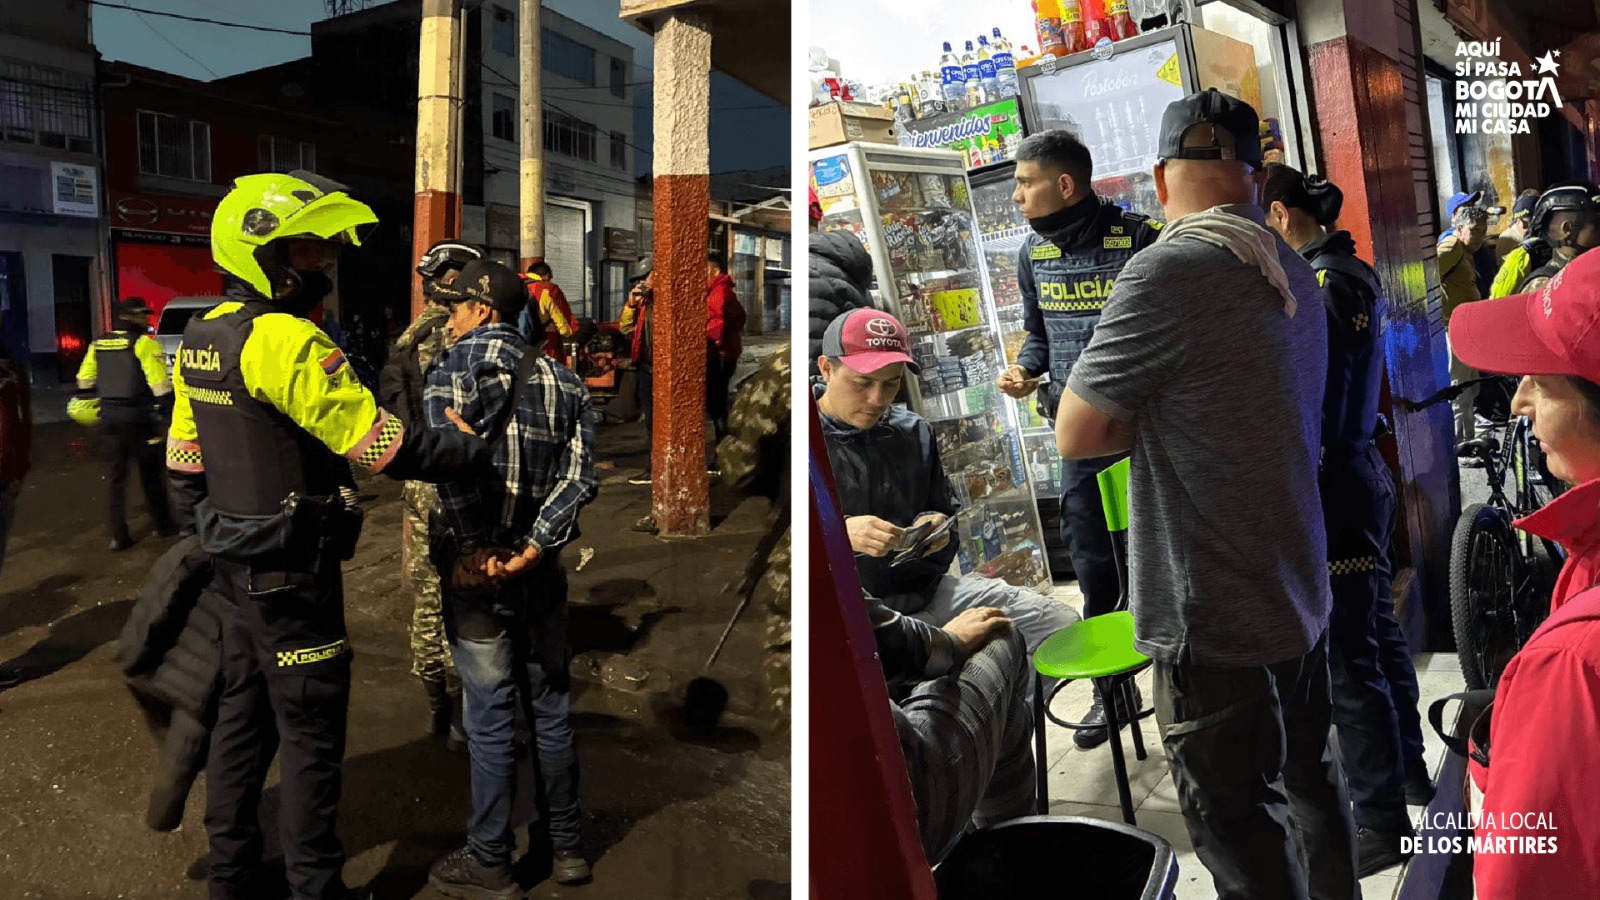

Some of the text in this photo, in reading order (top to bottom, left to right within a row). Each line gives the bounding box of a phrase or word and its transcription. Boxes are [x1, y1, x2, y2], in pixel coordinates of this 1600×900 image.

[1081, 70, 1138, 98] Postobón
[911, 113, 991, 147] ienvenidos
[1040, 274, 1114, 299] POLICÍA
[866, 338, 902, 347] TOYOTA
